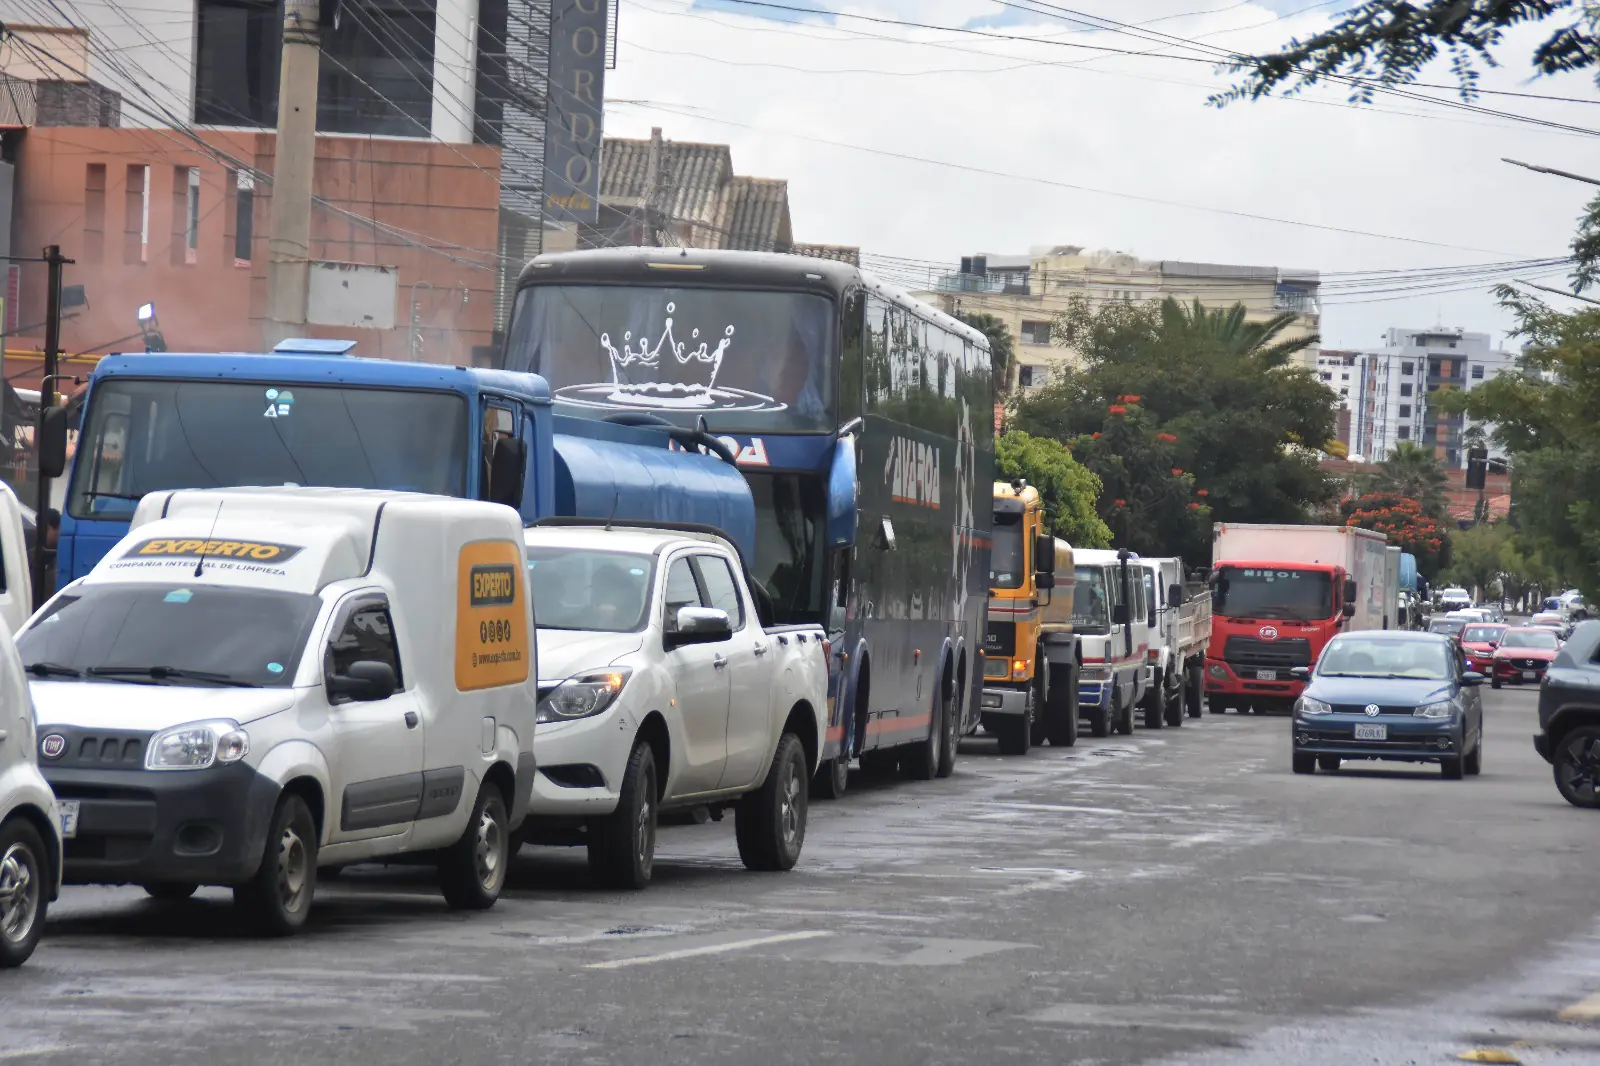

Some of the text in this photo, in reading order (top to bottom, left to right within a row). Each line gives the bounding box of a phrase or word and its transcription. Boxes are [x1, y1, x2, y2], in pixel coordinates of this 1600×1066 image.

[139, 539, 280, 559] EXPERTO
[165, 561, 216, 569] INTEGAL
[236, 564, 286, 576] LIMPIEZA
[473, 571, 511, 598] EXPERTO
